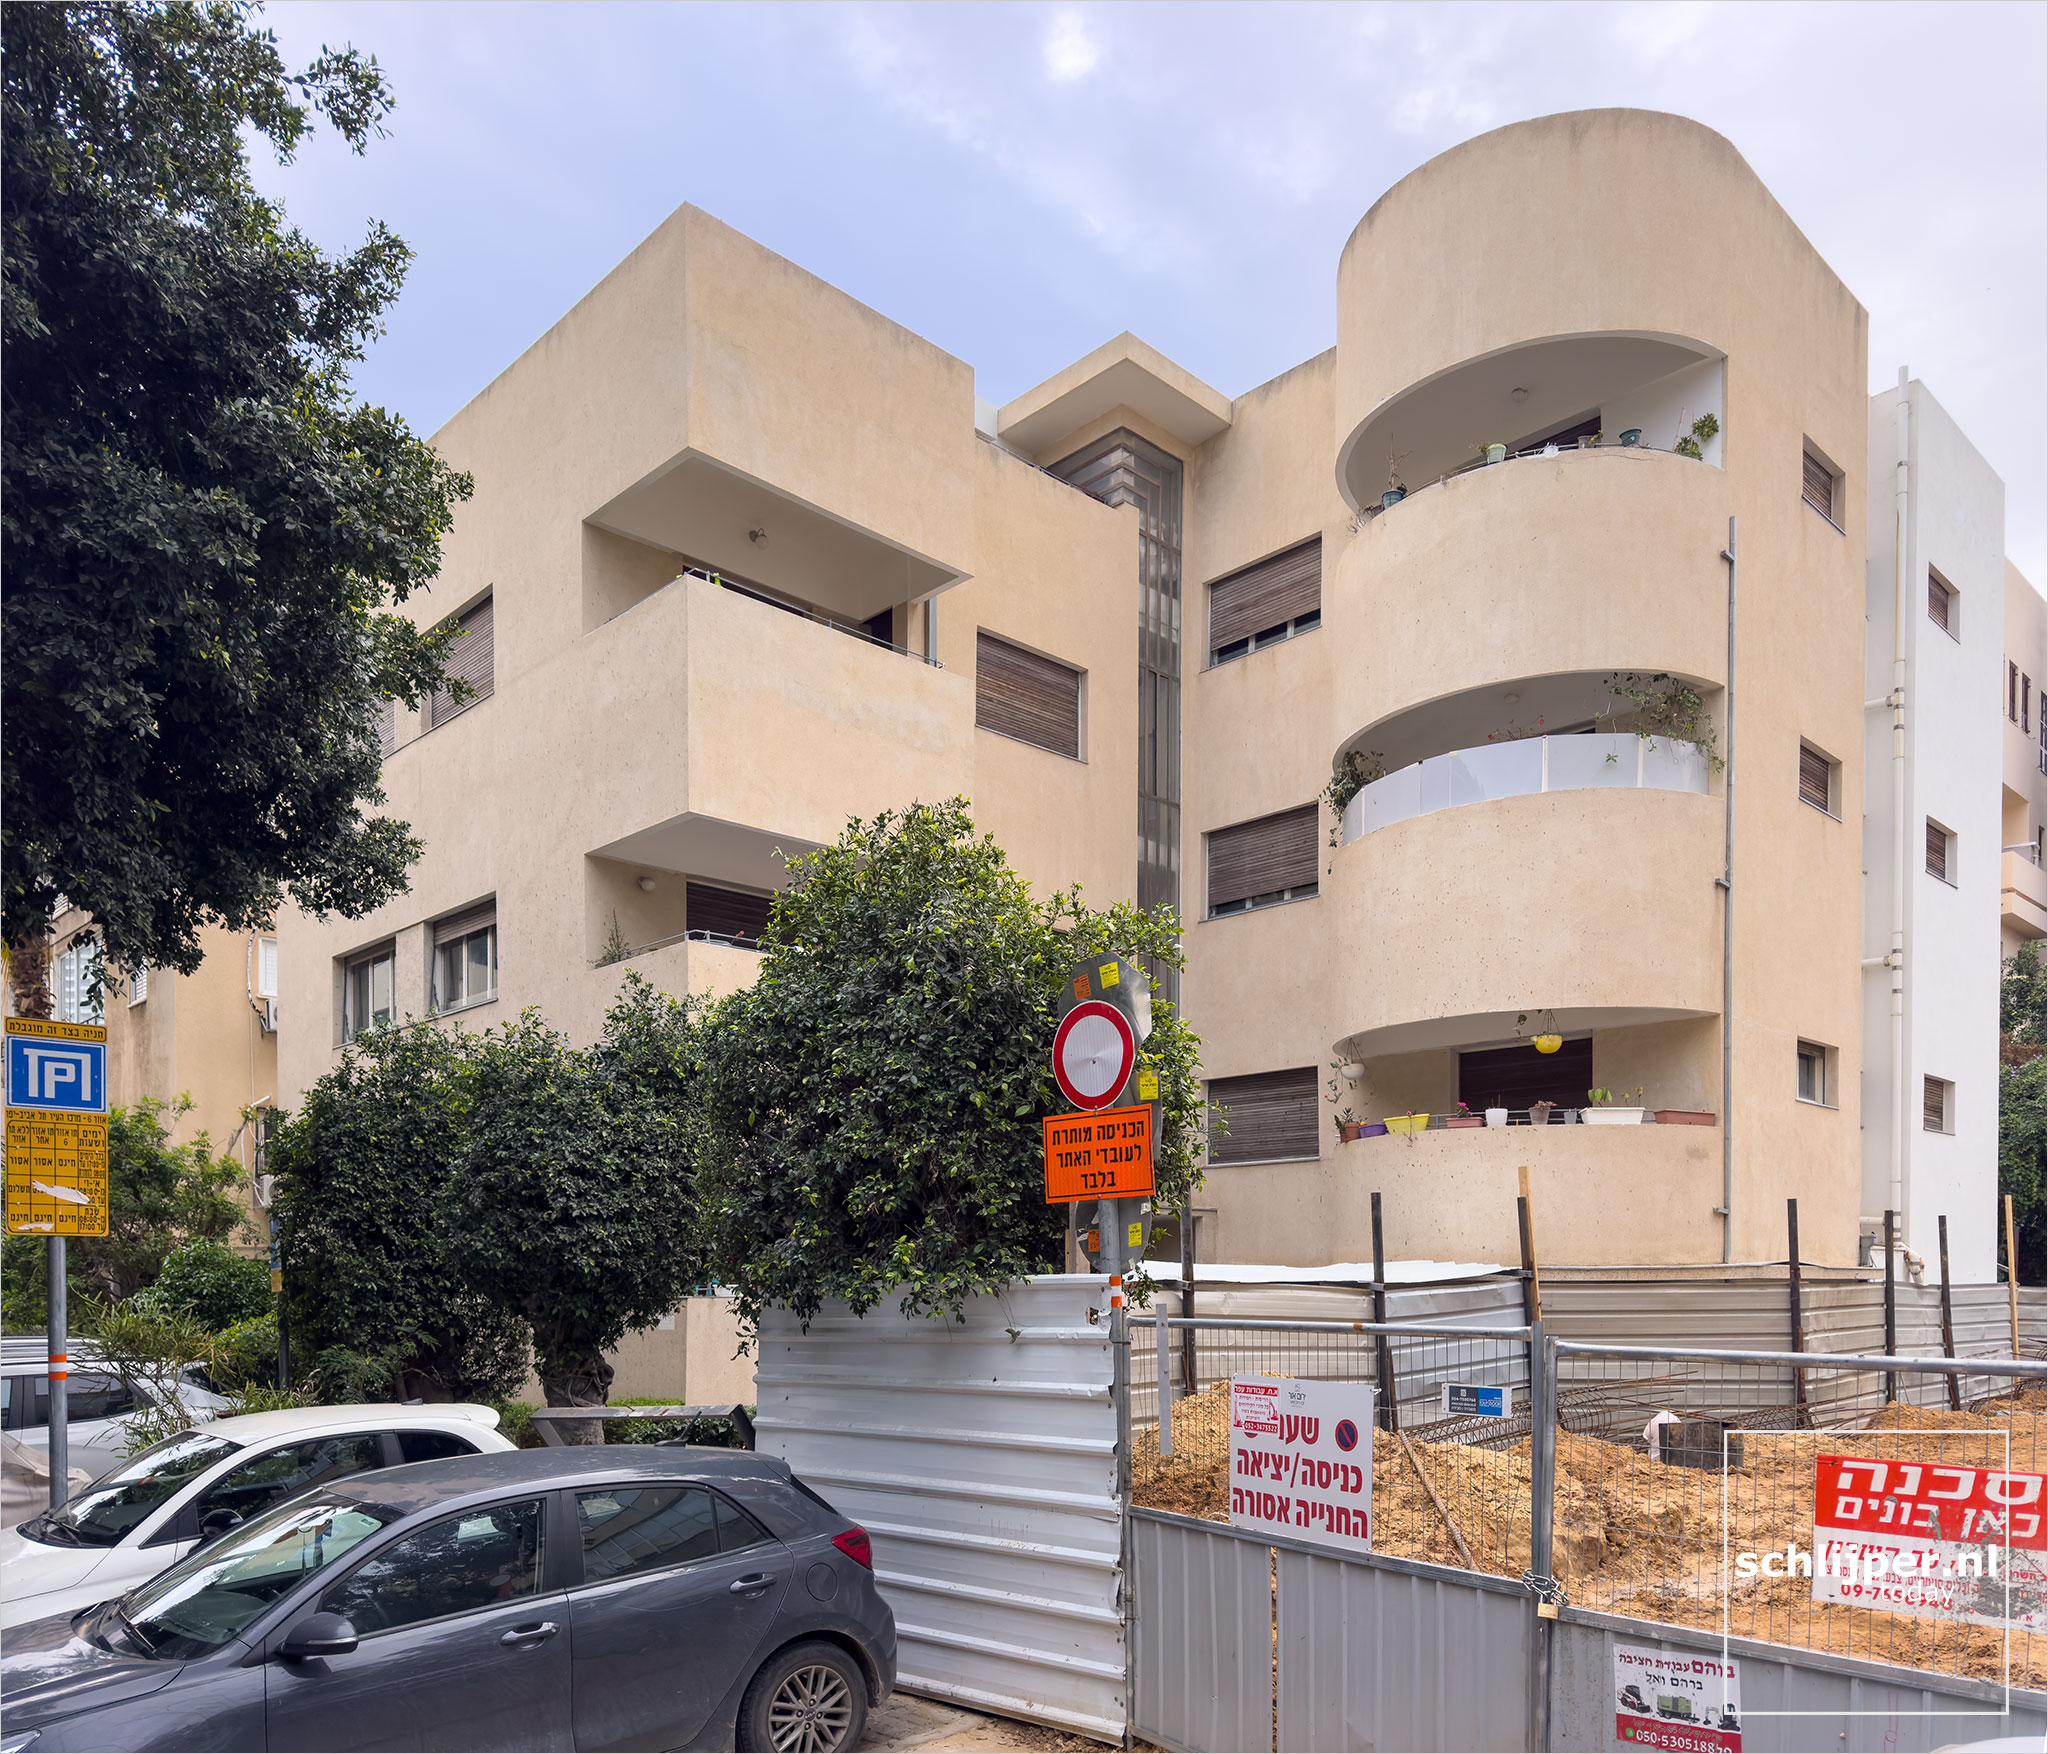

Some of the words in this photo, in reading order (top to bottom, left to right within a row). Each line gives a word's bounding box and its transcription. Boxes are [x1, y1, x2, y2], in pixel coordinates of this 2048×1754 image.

[10, 1022, 43, 1034] מוגבלת
[47, 1026, 58, 1035] זה
[62, 1028, 80, 1038] בצד
[84, 1030, 104, 1040] חניה
[82, 1130, 101, 1138] ימים
[1052, 1126, 1092, 1146] מותרת
[1096, 1120, 1145, 1140] הכניסה
[80, 1139, 104, 1147] ושעות
[1056, 1149, 1091, 1168] האתר
[1096, 1144, 1142, 1164] לעובדי
[10, 1157, 29, 1165] אסור
[34, 1158, 52, 1166] אסור
[58, 1158, 76, 1167] חינם
[1081, 1170, 1116, 1189] בלבד
[10, 1214, 28, 1222] חינם
[34, 1214, 52, 1222] חינם
[85, 1208, 99, 1216] שבת
[59, 1215, 77, 1223] חינם
[1237, 1448, 1362, 1494] כניסה/יציאה
[1836, 1460, 2043, 1506] סכנה
[1232, 1487, 1290, 1524] אסורה
[1834, 1496, 1939, 1528] בונים
[1296, 1499, 1368, 1539] החנייה
[1960, 1508, 2040, 1538] כאן
[1618, 1654, 1652, 1667] חציבה
[1670, 1676, 1703, 1690] ברהם
